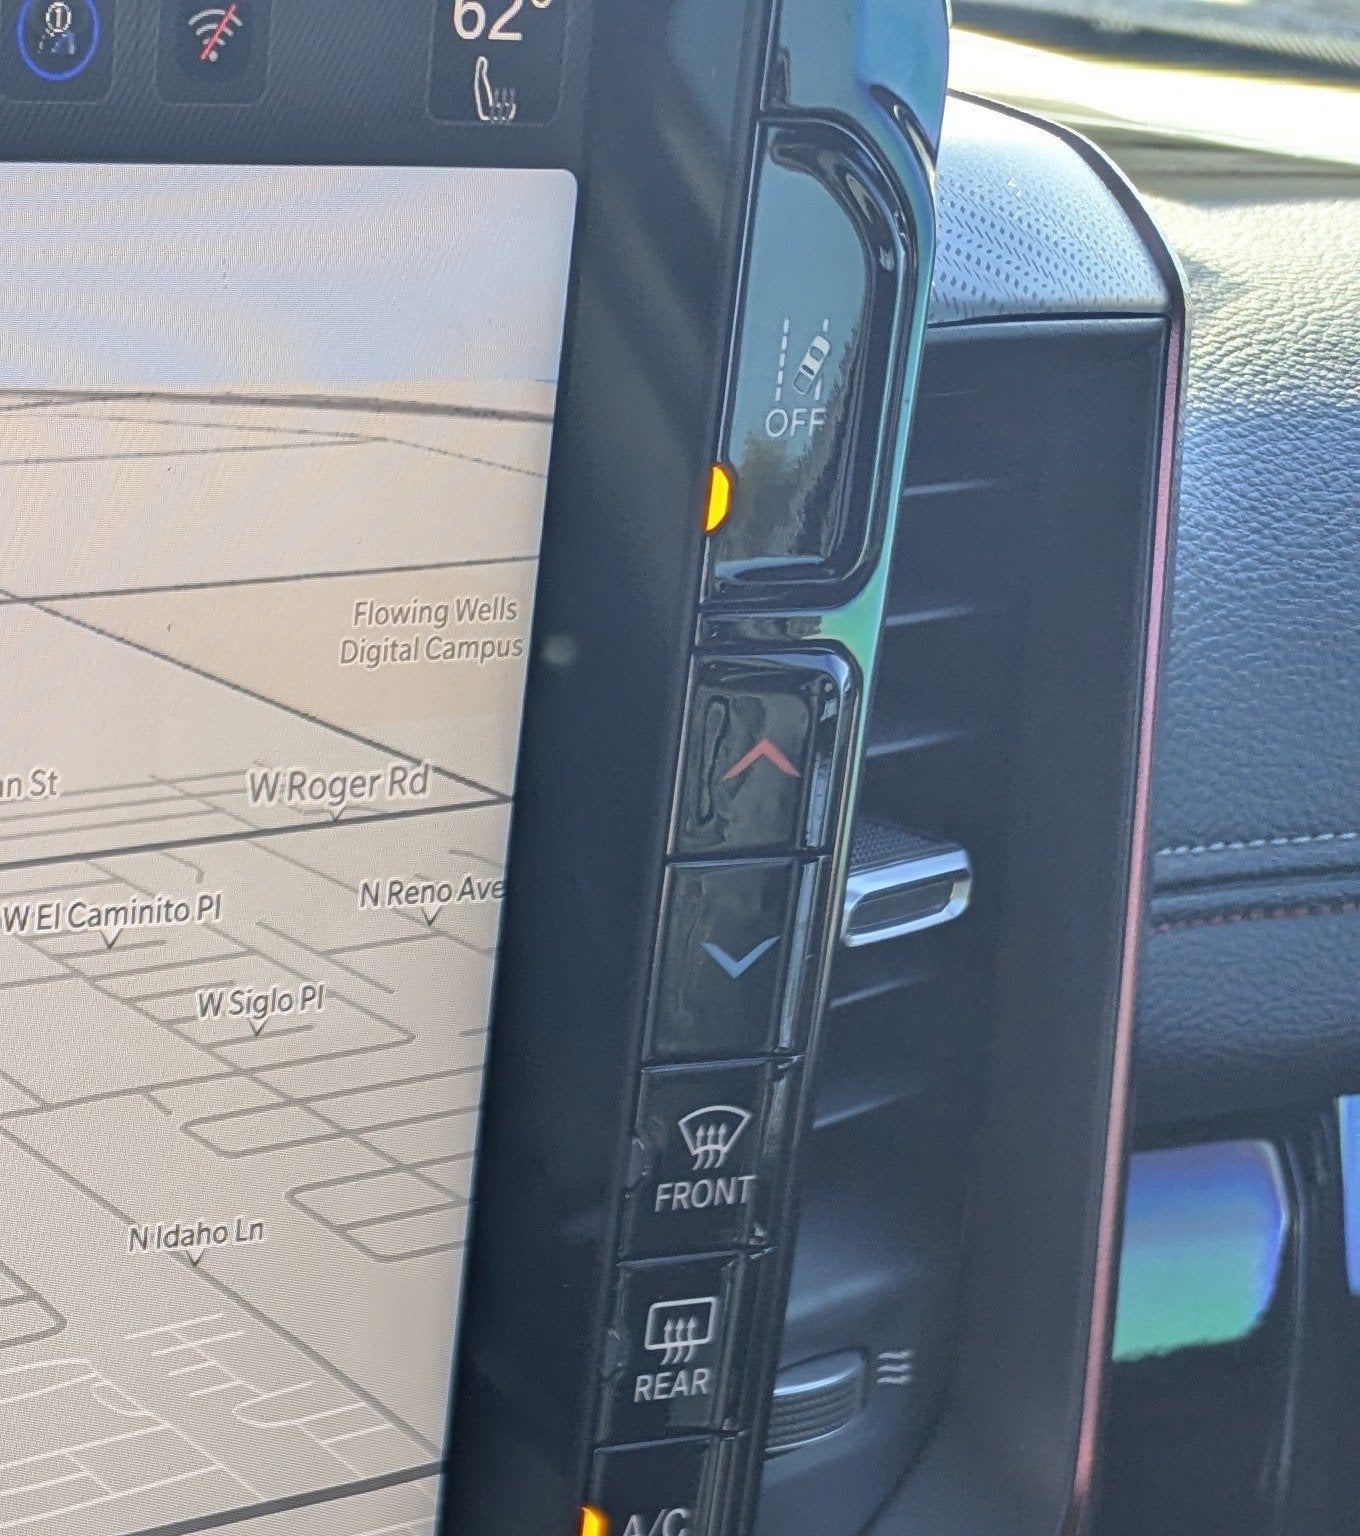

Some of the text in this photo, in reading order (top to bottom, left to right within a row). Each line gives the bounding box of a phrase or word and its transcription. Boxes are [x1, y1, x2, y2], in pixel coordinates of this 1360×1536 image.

[765, 406, 827, 439] OFF
[353, 597, 518, 629] Flowing Wells
[340, 636, 524, 667] Digital Campus
[31, 768, 58, 796] St
[250, 764, 429, 804] W Roger Rd
[360, 876, 505, 908] N Reno Ave
[3, 894, 222, 932] W El Caminito Pl
[197, 985, 324, 1020] W Siglo Pl
[654, 1174, 756, 1212] FRONT
[129, 1218, 265, 1252] N Idaho Ln
[633, 1368, 710, 1404] REAR
